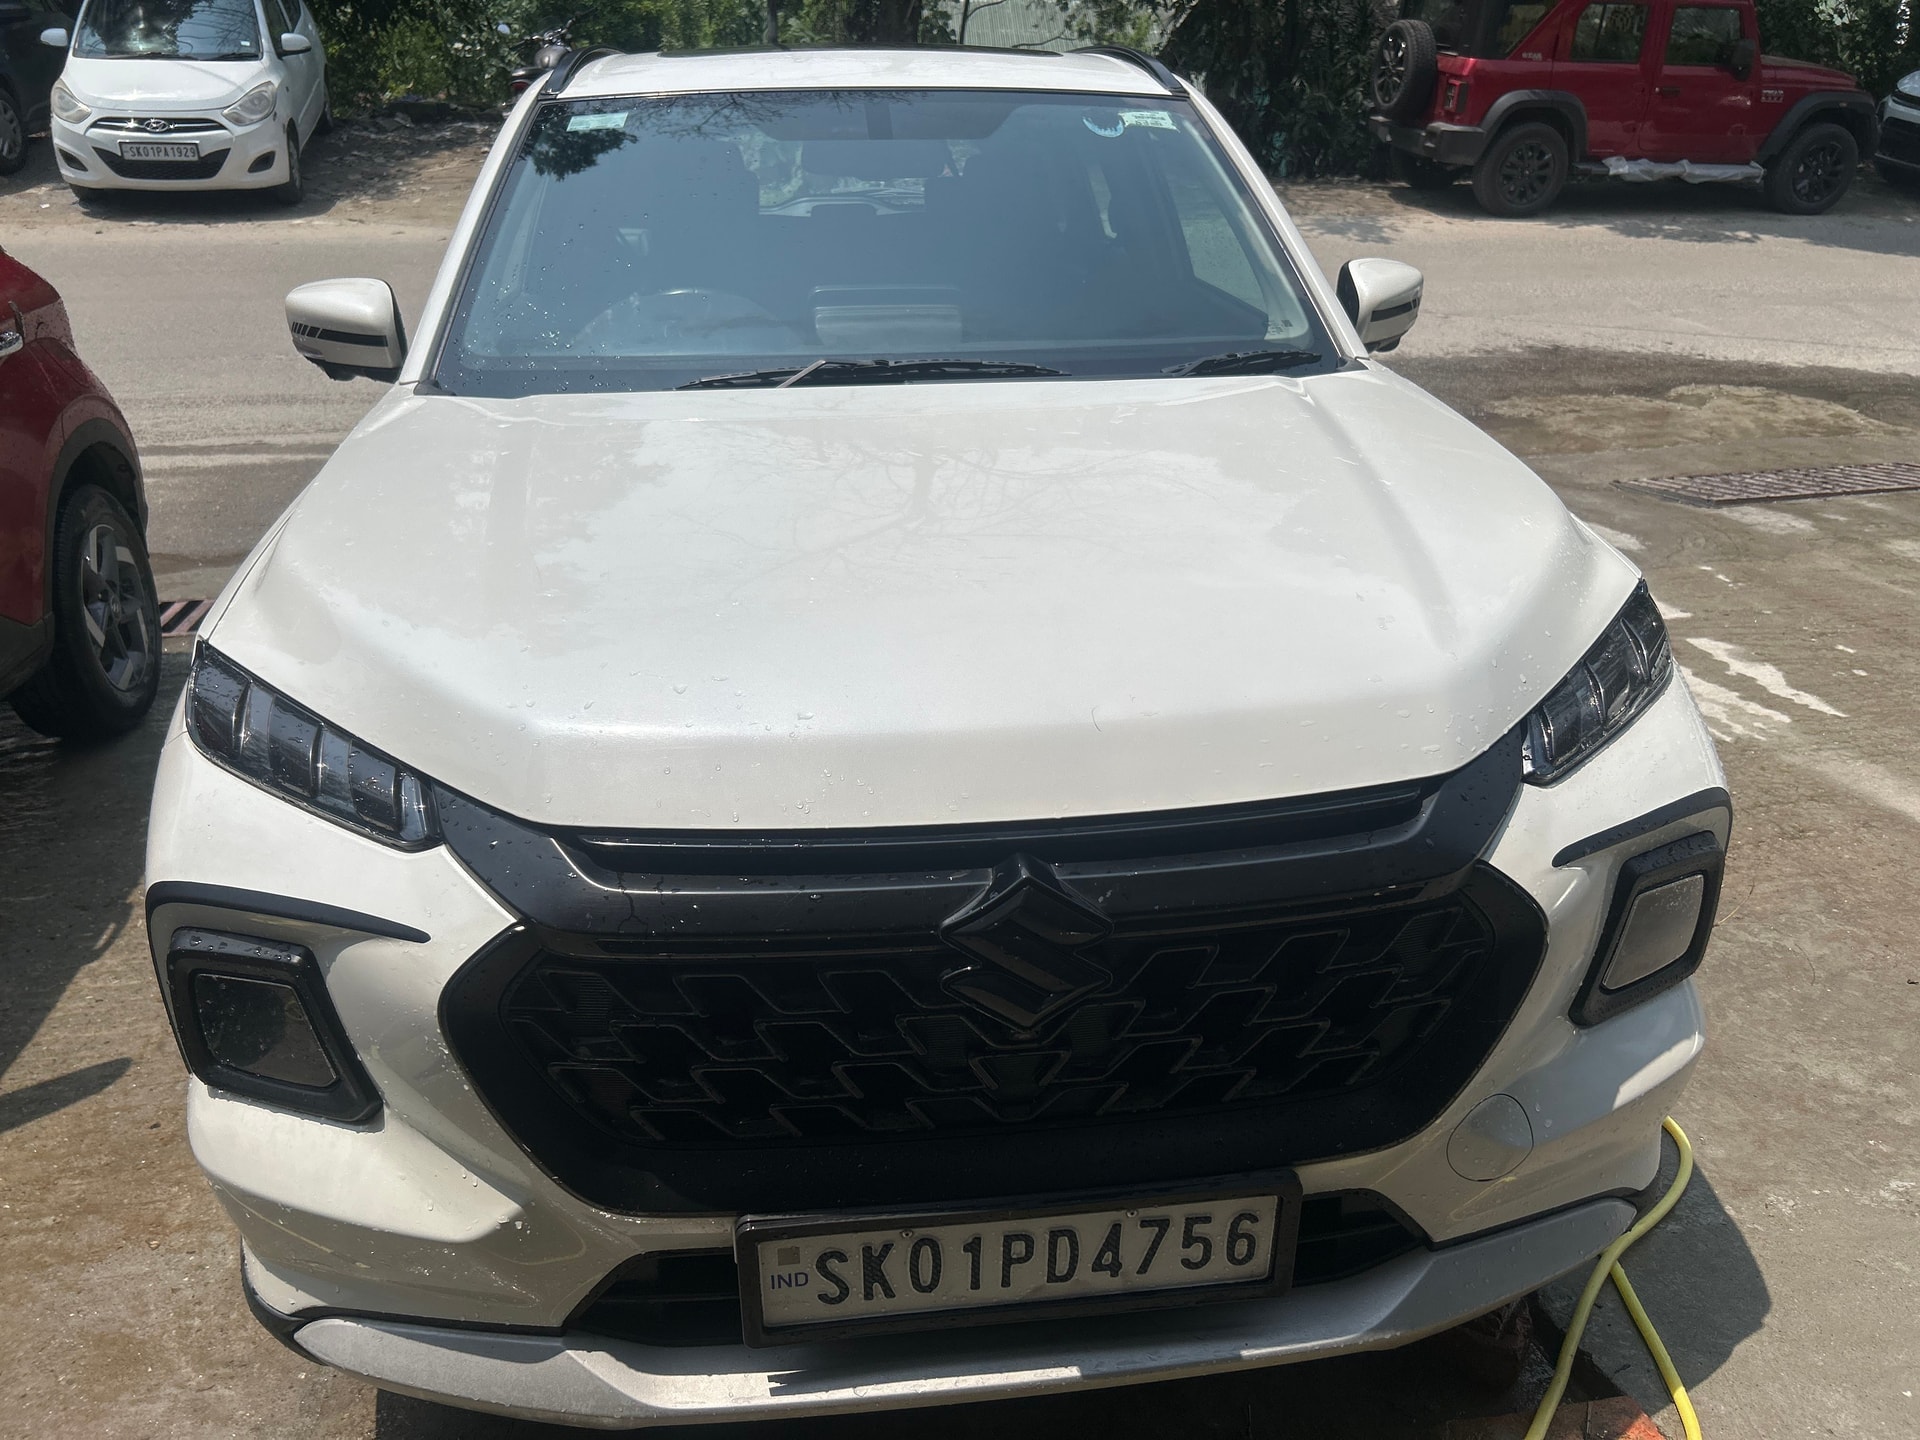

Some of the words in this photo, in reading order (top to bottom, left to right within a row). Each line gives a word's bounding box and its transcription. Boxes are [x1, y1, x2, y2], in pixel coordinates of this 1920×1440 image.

[129, 146, 196, 158] SK01PA1929
[770, 1271, 809, 1290] IND
[815, 1213, 1260, 1306] SK01PD4756
